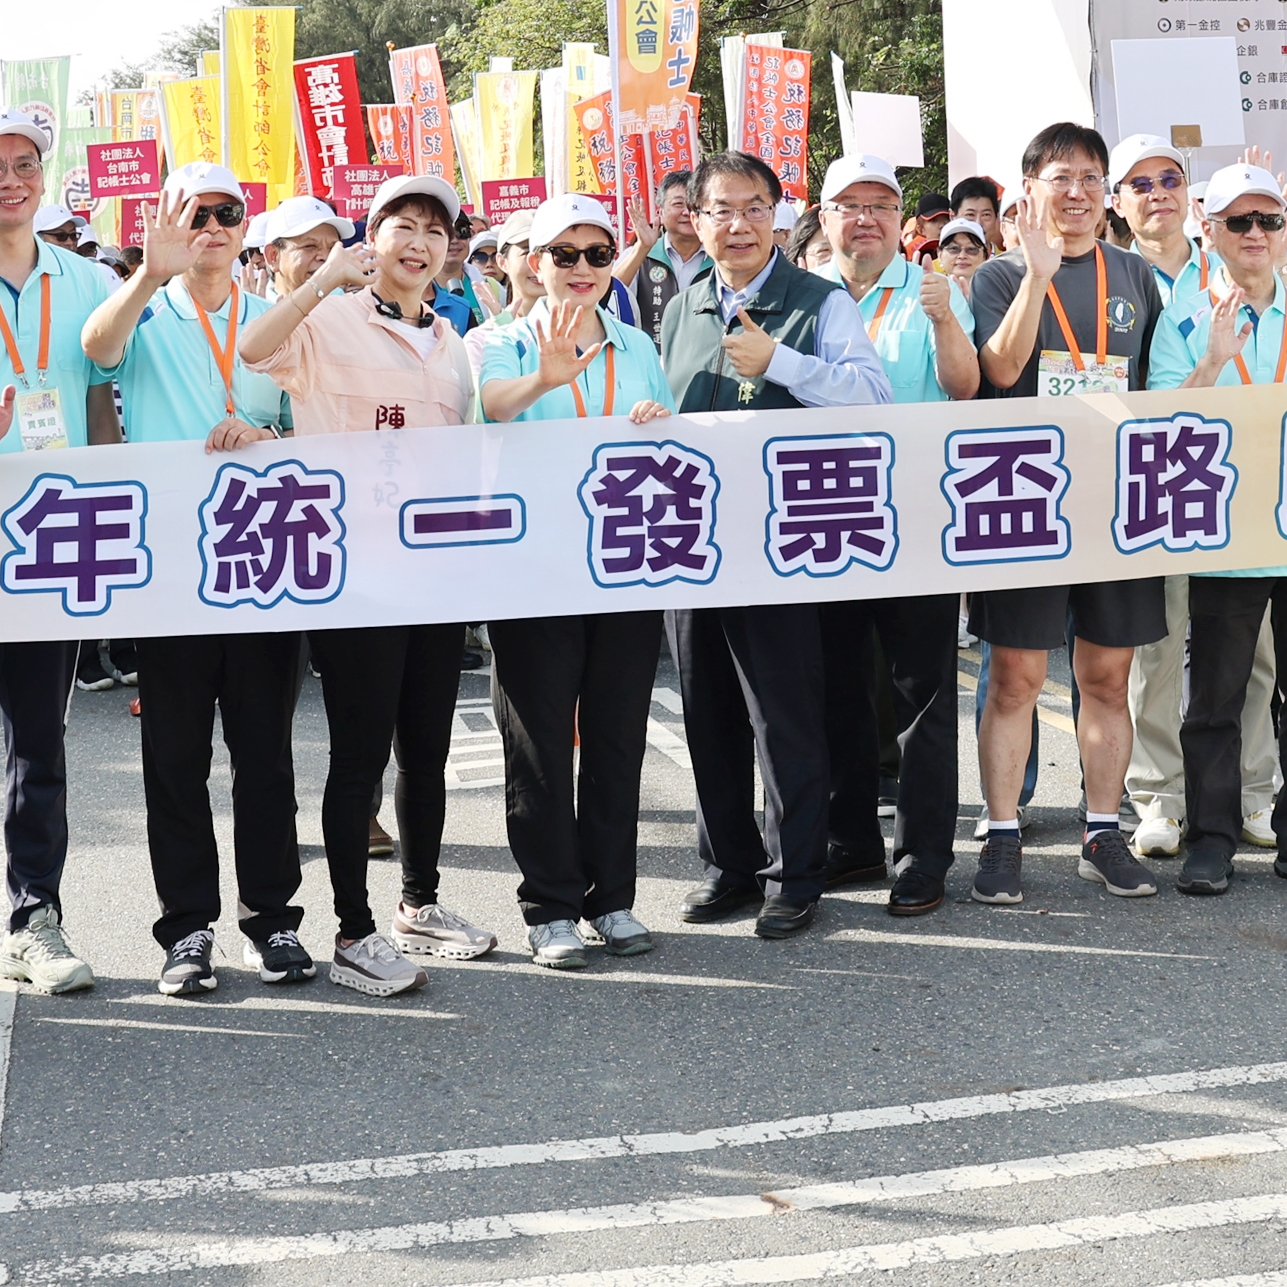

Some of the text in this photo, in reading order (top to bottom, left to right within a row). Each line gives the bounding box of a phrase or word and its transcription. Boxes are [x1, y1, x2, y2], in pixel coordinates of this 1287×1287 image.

[1175, 19, 1221, 31] 第一金控
[1236, 45, 1259, 57] 企銀
[99, 147, 144, 162] 社團法人
[106, 160, 139, 176] 台南市
[97, 173, 151, 189] 記帳士公會
[344, 169, 390, 182] 社團法人
[498, 183, 530, 197] 嘉義市
